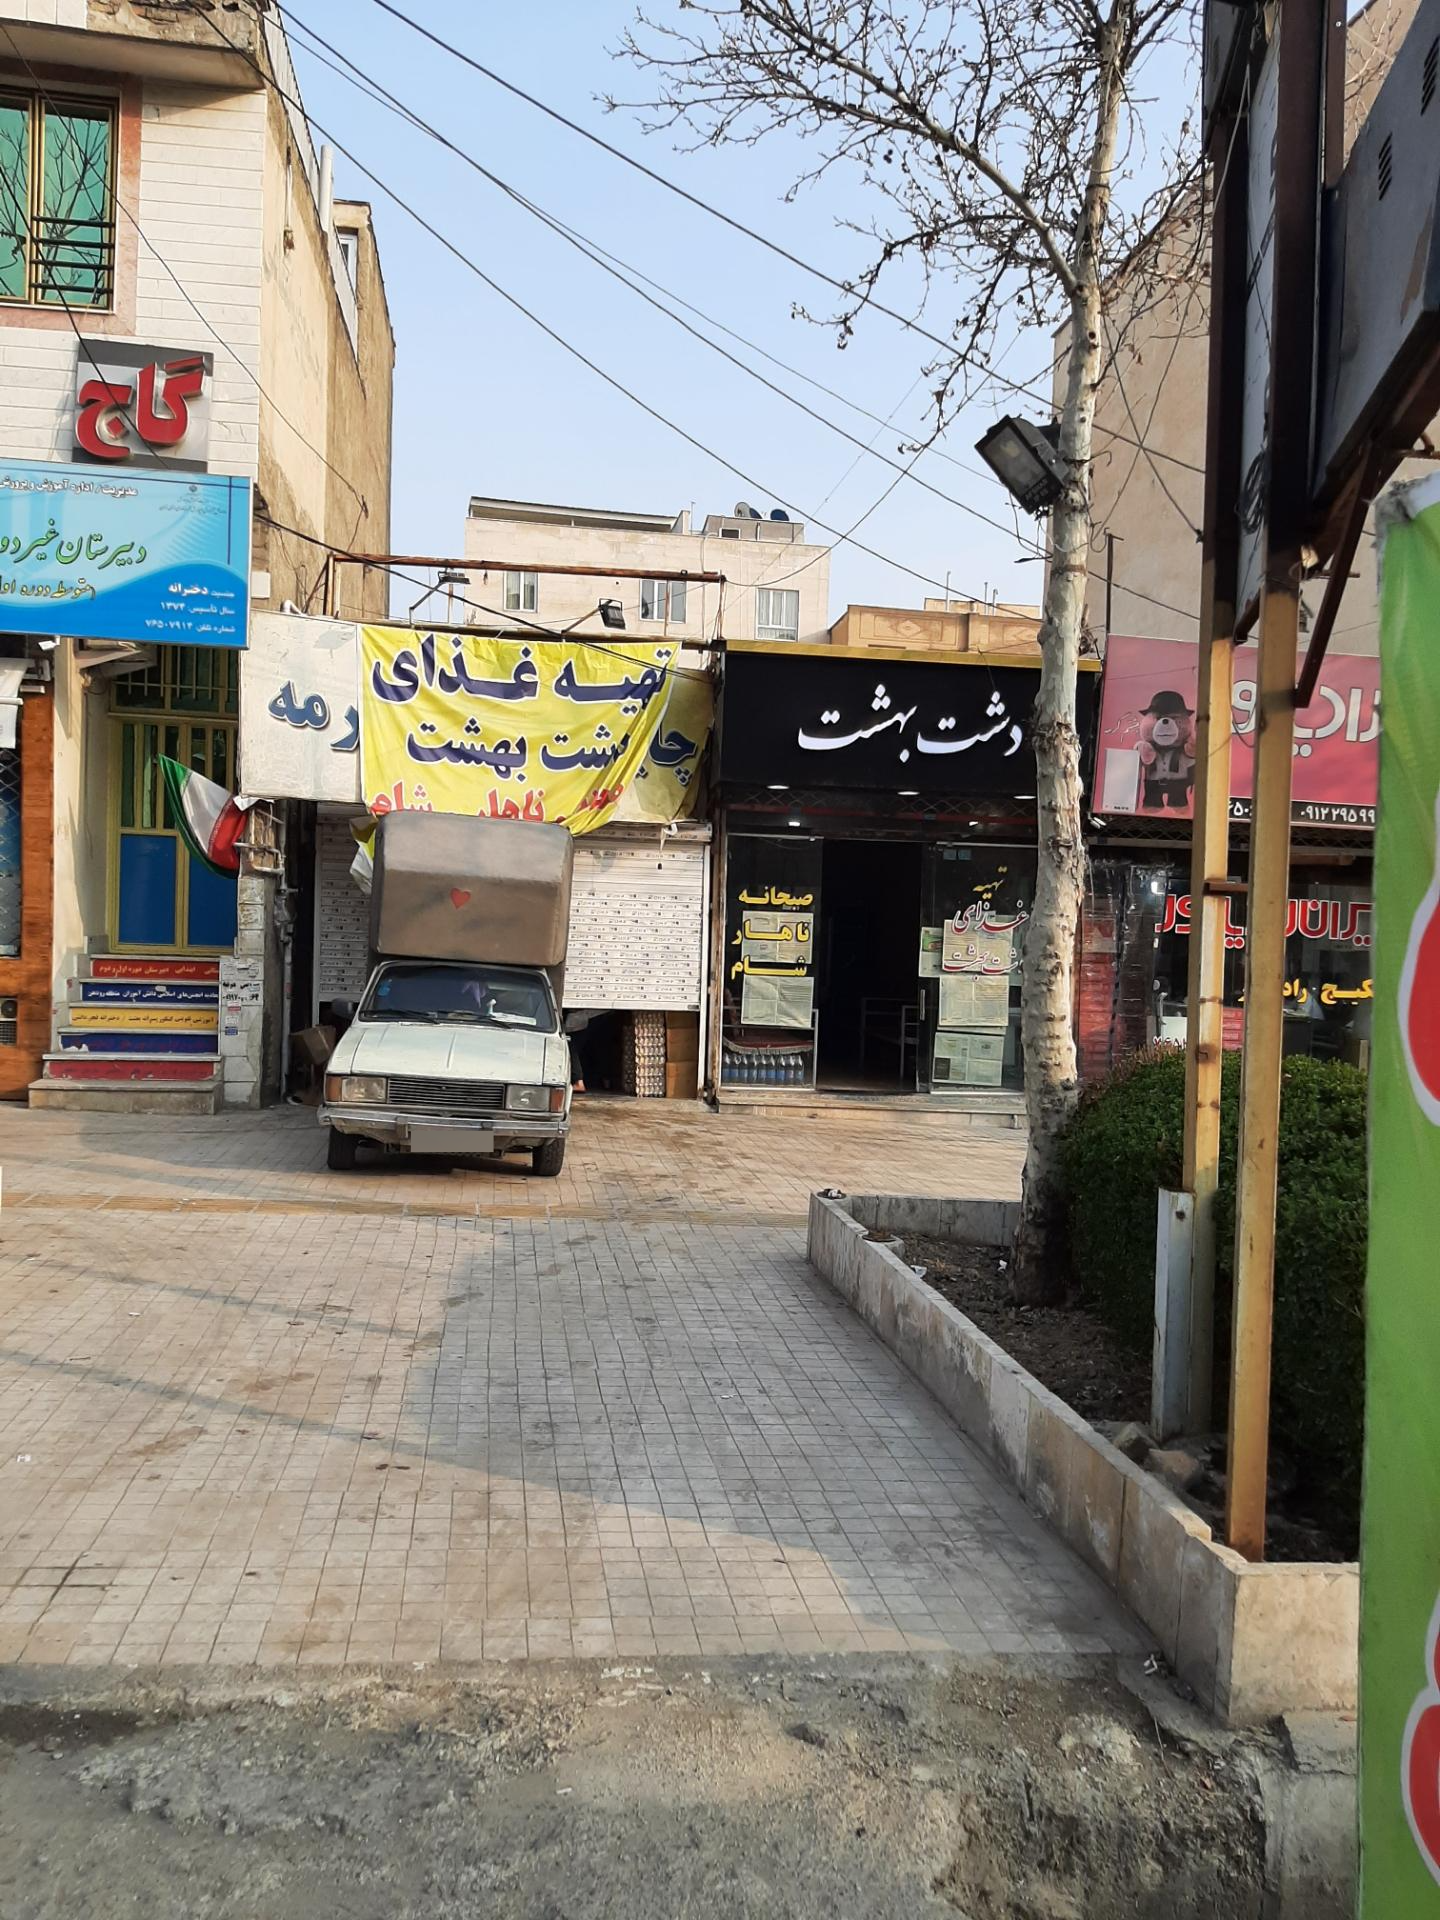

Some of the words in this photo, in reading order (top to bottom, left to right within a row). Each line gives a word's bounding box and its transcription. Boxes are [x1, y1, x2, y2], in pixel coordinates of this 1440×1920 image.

[76, 355, 205, 460] گاج
[36, 478, 69, 491] آموزش
[72, 482, 94, 495] اداره
[101, 485, 138, 498] مدیریت
[13, 518, 60, 564] غیر
[56, 533, 147, 570] دبیرستان
[20, 584, 51, 597] دوره
[168, 582, 208, 597] دخترانه
[219, 606, 235, 615] سال
[213, 625, 236, 634] شماره
[372, 633, 539, 703] غذای
[552, 647, 672, 715] تهیه
[797, 683, 918, 763] بهشت
[916, 690, 1024, 757] دشت
[406, 717, 528, 782] بهشت
[478, 788, 545, 822] ناها
[738, 886, 814, 912] صبحانه
[973, 866, 1008, 899] تهیه
[731, 919, 811, 945] ناهار
[952, 900, 1029, 935] غذای
[731, 955, 807, 980] شام
[942, 944, 989, 982] بهشت
